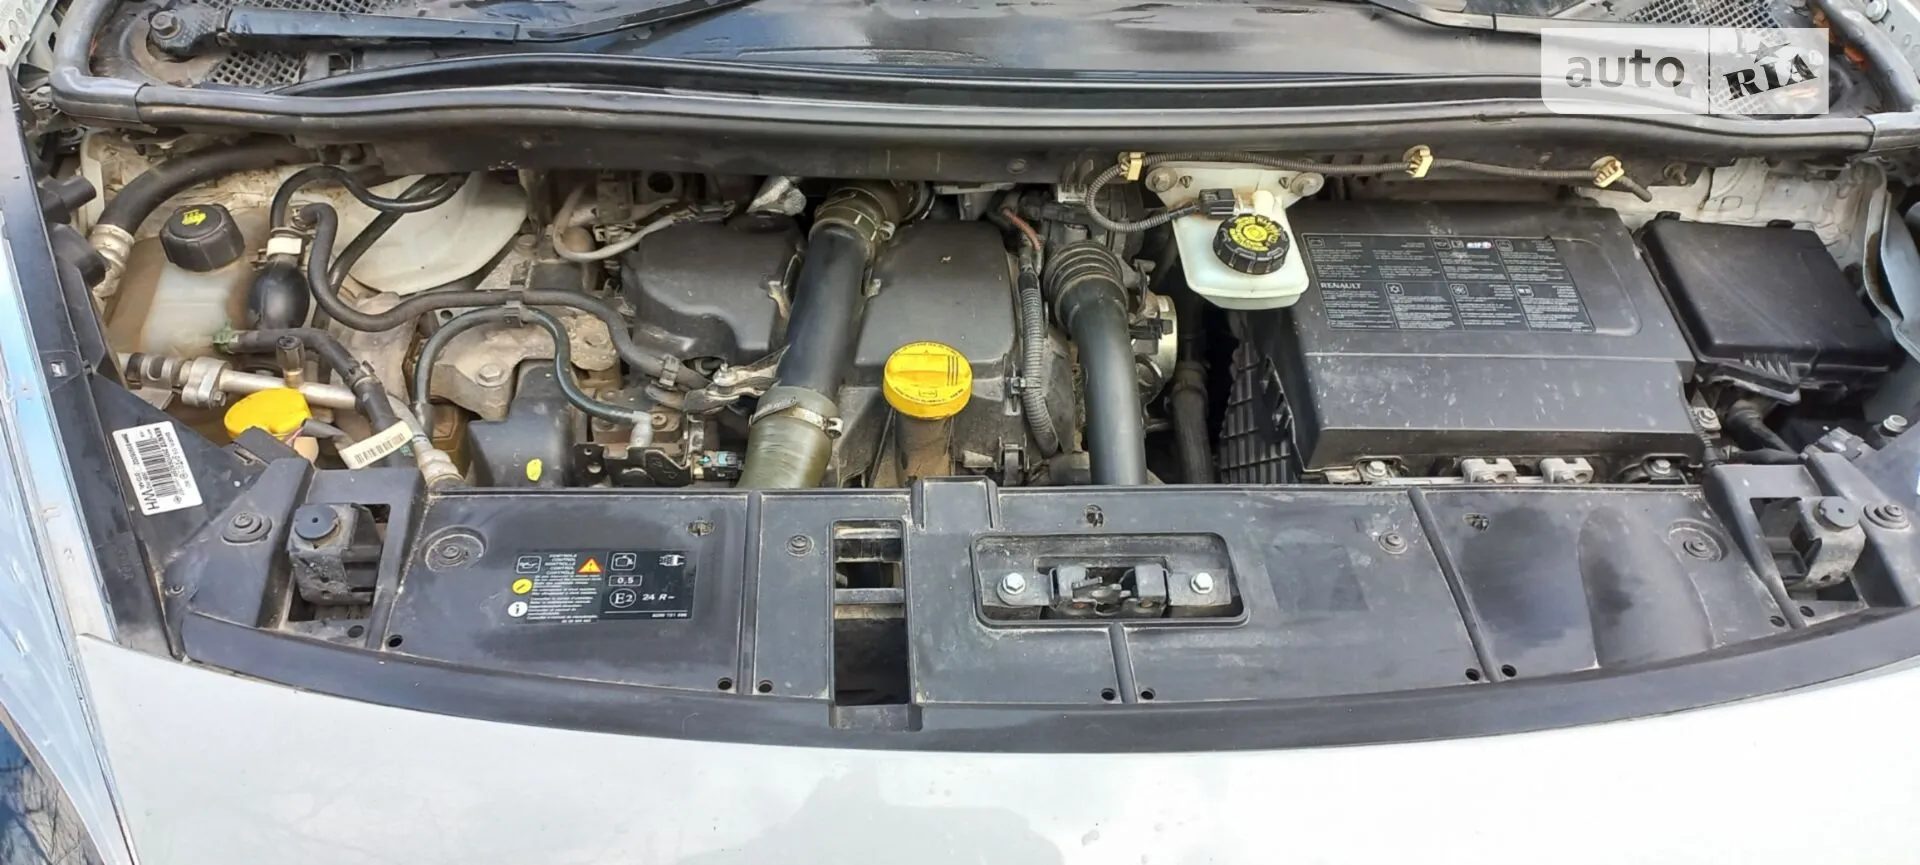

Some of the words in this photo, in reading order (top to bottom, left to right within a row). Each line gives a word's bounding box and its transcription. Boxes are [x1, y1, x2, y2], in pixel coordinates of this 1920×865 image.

[141, 488, 160, 510] WH
[614, 592, 633, 604] E2
[642, 593, 655, 601] 24
